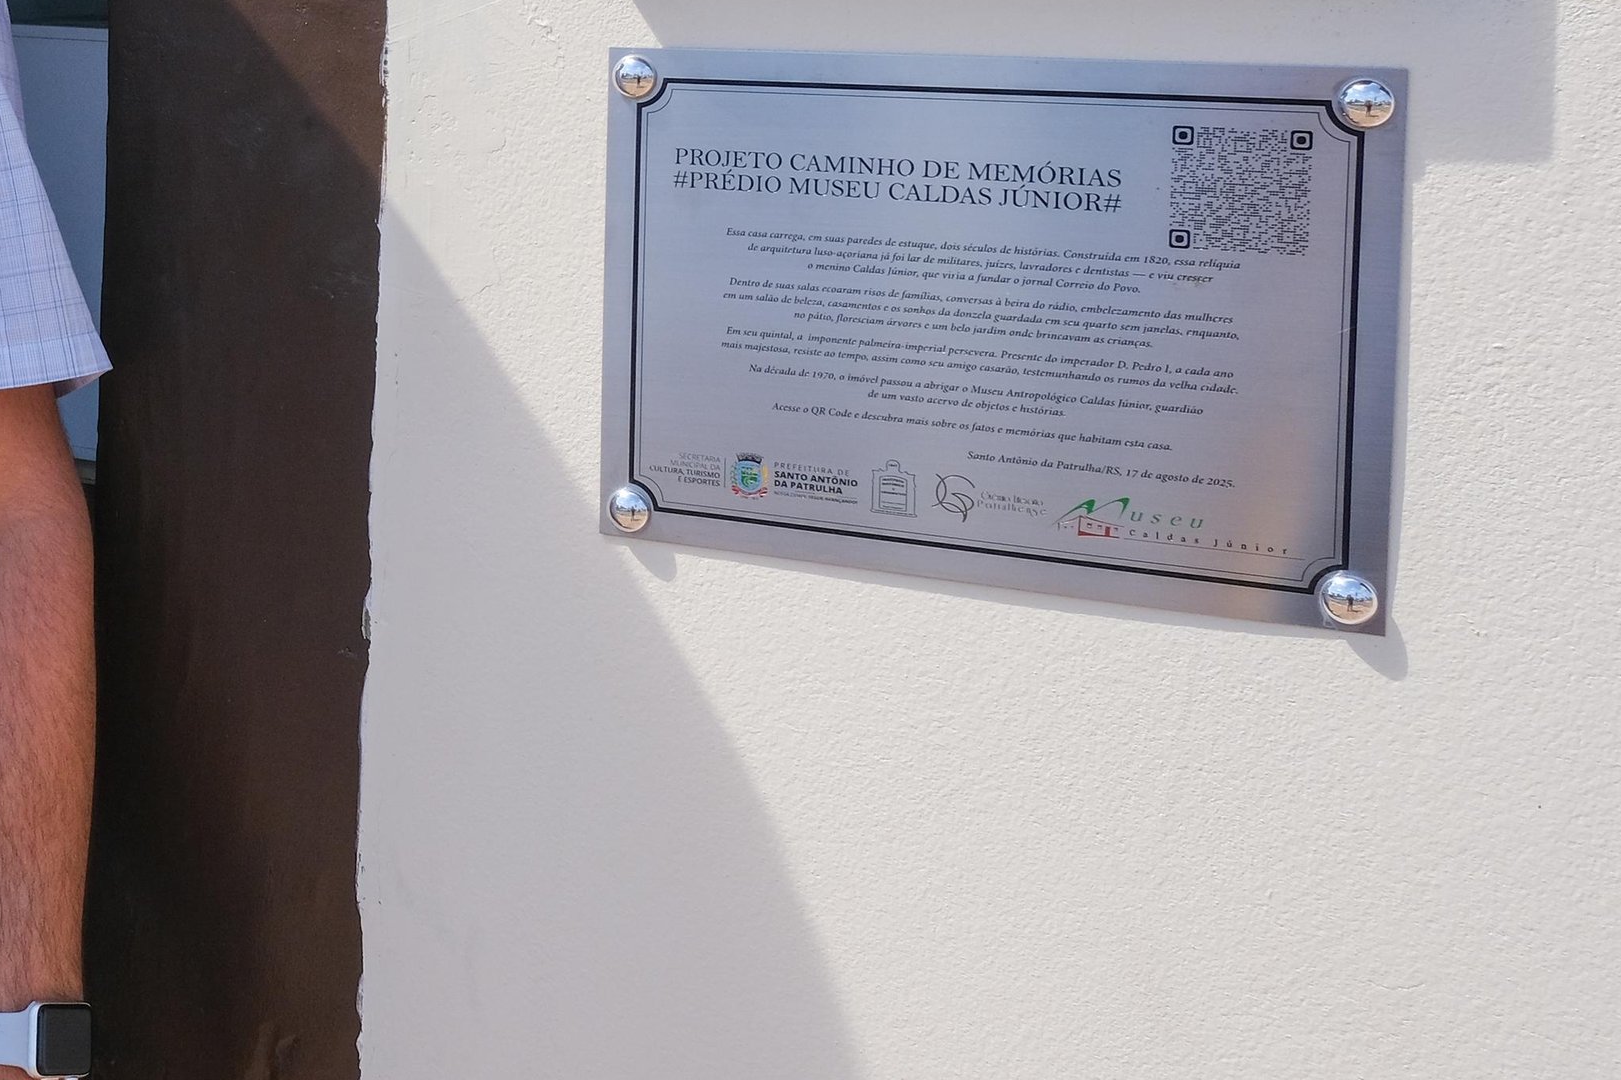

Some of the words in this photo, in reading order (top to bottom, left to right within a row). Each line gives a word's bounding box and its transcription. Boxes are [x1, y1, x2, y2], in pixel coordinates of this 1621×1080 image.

[674, 147, 783, 170] PROJETO
[789, 153, 915, 177] CAMINHO
[921, 159, 960, 180] DE
[966, 160, 1122, 188] MEMÓRIAS
[672, 168, 782, 194] #PRÉDIO
[787, 176, 881, 199] MUSEU
[888, 181, 992, 206] CALDAS
[999, 185, 1122, 212] JÚNIOR#
[725, 226, 746, 237] Essa
[747, 230, 768, 238] casa
[823, 235, 845, 243] suas
[845, 235, 883, 246] paredes
[939, 240, 961, 251] dois
[962, 242, 998, 254] séculos
[1062, 248, 1122, 262] Construída
[1173, 258, 1196, 266] essa
[1197, 257, 1241, 271] relíquia
[759, 244, 812, 256] arquitetura
[879, 251, 890, 262] já
[889, 251, 905, 264] foi
[906, 252, 922, 263] lar
[1018, 260, 1073, 274] lavradores
[1082, 264, 1130, 278] dentistas
[1157, 270, 1174, 280] viu
[814, 262, 851, 272] menino
[852, 263, 886, 275] Caldas
[921, 270, 940, 281] que
[941, 271, 966, 281] viria
[975, 273, 1012, 286] fundar
[1020, 275, 1054, 287] jornal
[1054, 278, 1095, 290] Correio
[728, 276, 761, 288] Dentro
[774, 282, 795, 290] suas
[796, 282, 820, 292] salas
[821, 285, 861, 295] ecoaram
[863, 287, 886, 297] risos
[945, 295, 994, 306] conversas
[1003, 296, 1030, 308] beira
[1080, 304, 1161, 319] embelezamento
[1162, 309, 1182, 320] das
[1183, 312, 1234, 324] mulheres
[754, 292, 779, 303] salão
[826, 300, 882, 311] casamentos
[902, 305, 936, 315] sonhos
[937, 306, 951, 316] da
[952, 308, 992, 320] donzela
[992, 313, 1043, 324] guardada
[1062, 319, 1080, 327] seu
[1081, 320, 1118, 331] quarto
[1119, 323, 1141, 332] sem
[834, 312, 885, 326] floresciam
[886, 317, 922, 329] árvores
[949, 322, 971, 333] belo
[971, 325, 1006, 336] jardim
[1008, 328, 1034, 338] onde
[1035, 329, 1091, 342] brincavam
[720, 340, 742, 350] mais
[793, 347, 822, 357] resiste
[870, 354, 898, 364] assim
[899, 357, 927, 366] como
[927, 360, 945, 368] seu
[946, 361, 978, 373] amigo
[1022, 367, 1101, 382] testemunhando
[1116, 377, 1150, 387] rumos
[1169, 379, 1198, 391] velha
[725, 325, 741, 336] Em
[742, 329, 758, 337] seu
[807, 332, 857, 346] imponente
[1000, 349, 1043, 362] Presente
[1059, 355, 1115, 368] imperador
[1131, 361, 1163, 373] Pedro
[1183, 366, 1211, 376] cada
[1212, 370, 1234, 379] ano
[748, 363, 763, 373] Na
[763, 364, 797, 376] década
[847, 372, 879, 384] imóvel
[879, 377, 913, 388] passou
[922, 380, 960, 393] abrigar
[969, 384, 1004, 396] Museu
[1005, 388, 1077, 404] Antropológico
[1079, 394, 1116, 407] Caldas
[1153, 403, 1204, 415] guardião
[881, 392, 897, 400] um
[899, 394, 925, 403] vasto
[926, 396, 959, 407] acervo
[974, 399, 1010, 412] objetos
[771, 401, 801, 413] Acesse
[810, 405, 826, 417] QR
[827, 407, 853, 418] Code
[860, 410, 904, 423] descubra
[905, 416, 929, 426] mais
[930, 418, 957, 429] sobre
[969, 421, 995, 433] fatos
[1004, 427, 1056, 439] memórias
[1057, 433, 1077, 443] que
[1078, 432, 1122, 446] habitam
[1123, 439, 1145, 448] esta
[683, 477, 721, 487] ESPORTES
[686, 469, 721, 479] TURISMO
[774, 462, 833, 474] PREFEITURA
[837, 469, 849, 477] DE
[774, 470, 808, 481] SANTO
[810, 473, 858, 487] ANTÔNIO
[966, 450, 996, 462] Santo
[996, 454, 1039, 467] Antônio
[1125, 468, 1139, 478] 17
[1154, 473, 1190, 483] agosto
[774, 480, 788, 489] DA
[790, 482, 843, 495] PATRULHA
[1129, 528, 1200, 544] Caldas
[1213, 538, 1288, 555] Júnior
